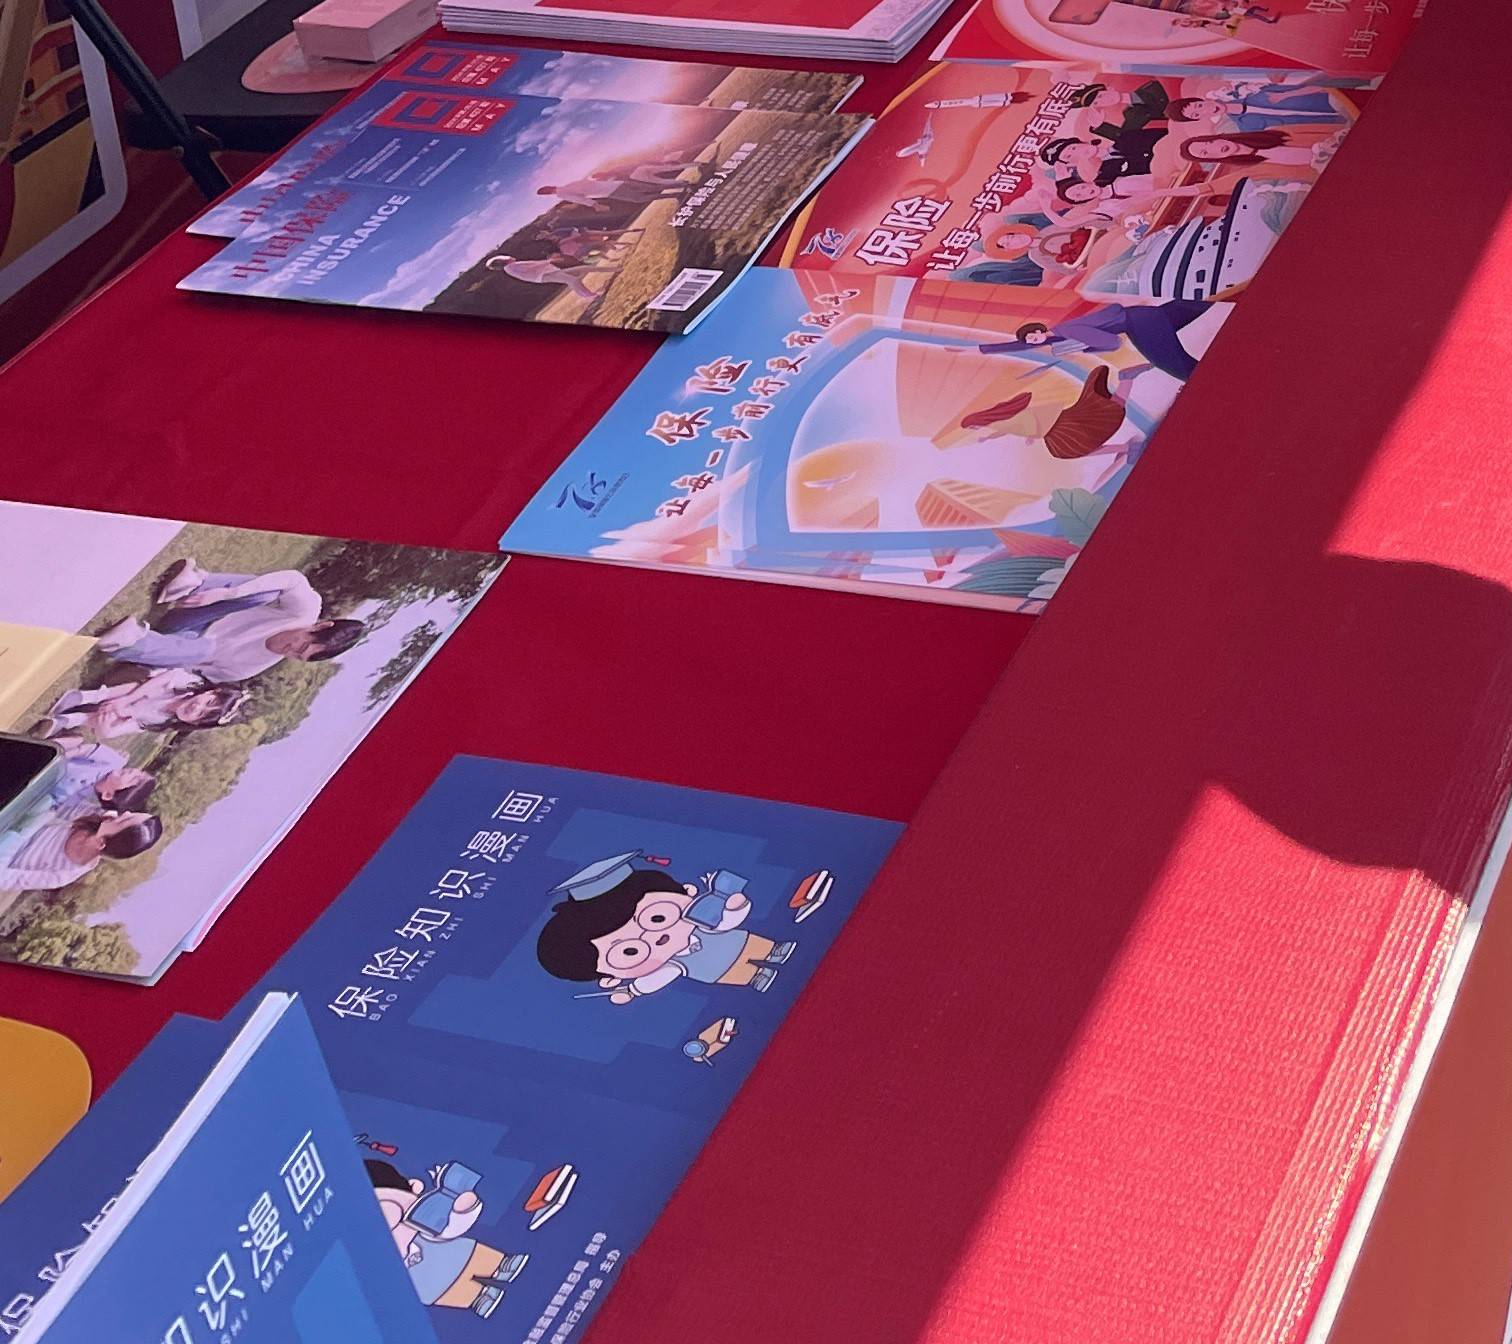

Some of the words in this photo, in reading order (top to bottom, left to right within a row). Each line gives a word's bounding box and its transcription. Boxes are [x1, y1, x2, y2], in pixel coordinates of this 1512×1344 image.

[926, 81, 1086, 271] 让每一步前行更有底气
[274, 234, 342, 283] CHINA
[298, 193, 412, 286] INSURANCE
[856, 195, 952, 267] 保险
[646, 355, 752, 446] 保险
[328, 789, 544, 1018] 保险知识漫画
[369, 993, 398, 1021] BAO
[403, 950, 437, 982] XIAN
[439, 916, 464, 940] ZHI
[473, 875, 497, 900] SHI
[502, 834, 530, 863] MAN
[533, 796, 560, 823] HUA
[260, 1242, 294, 1293] MAN
[303, 1186, 335, 1231] HUA
